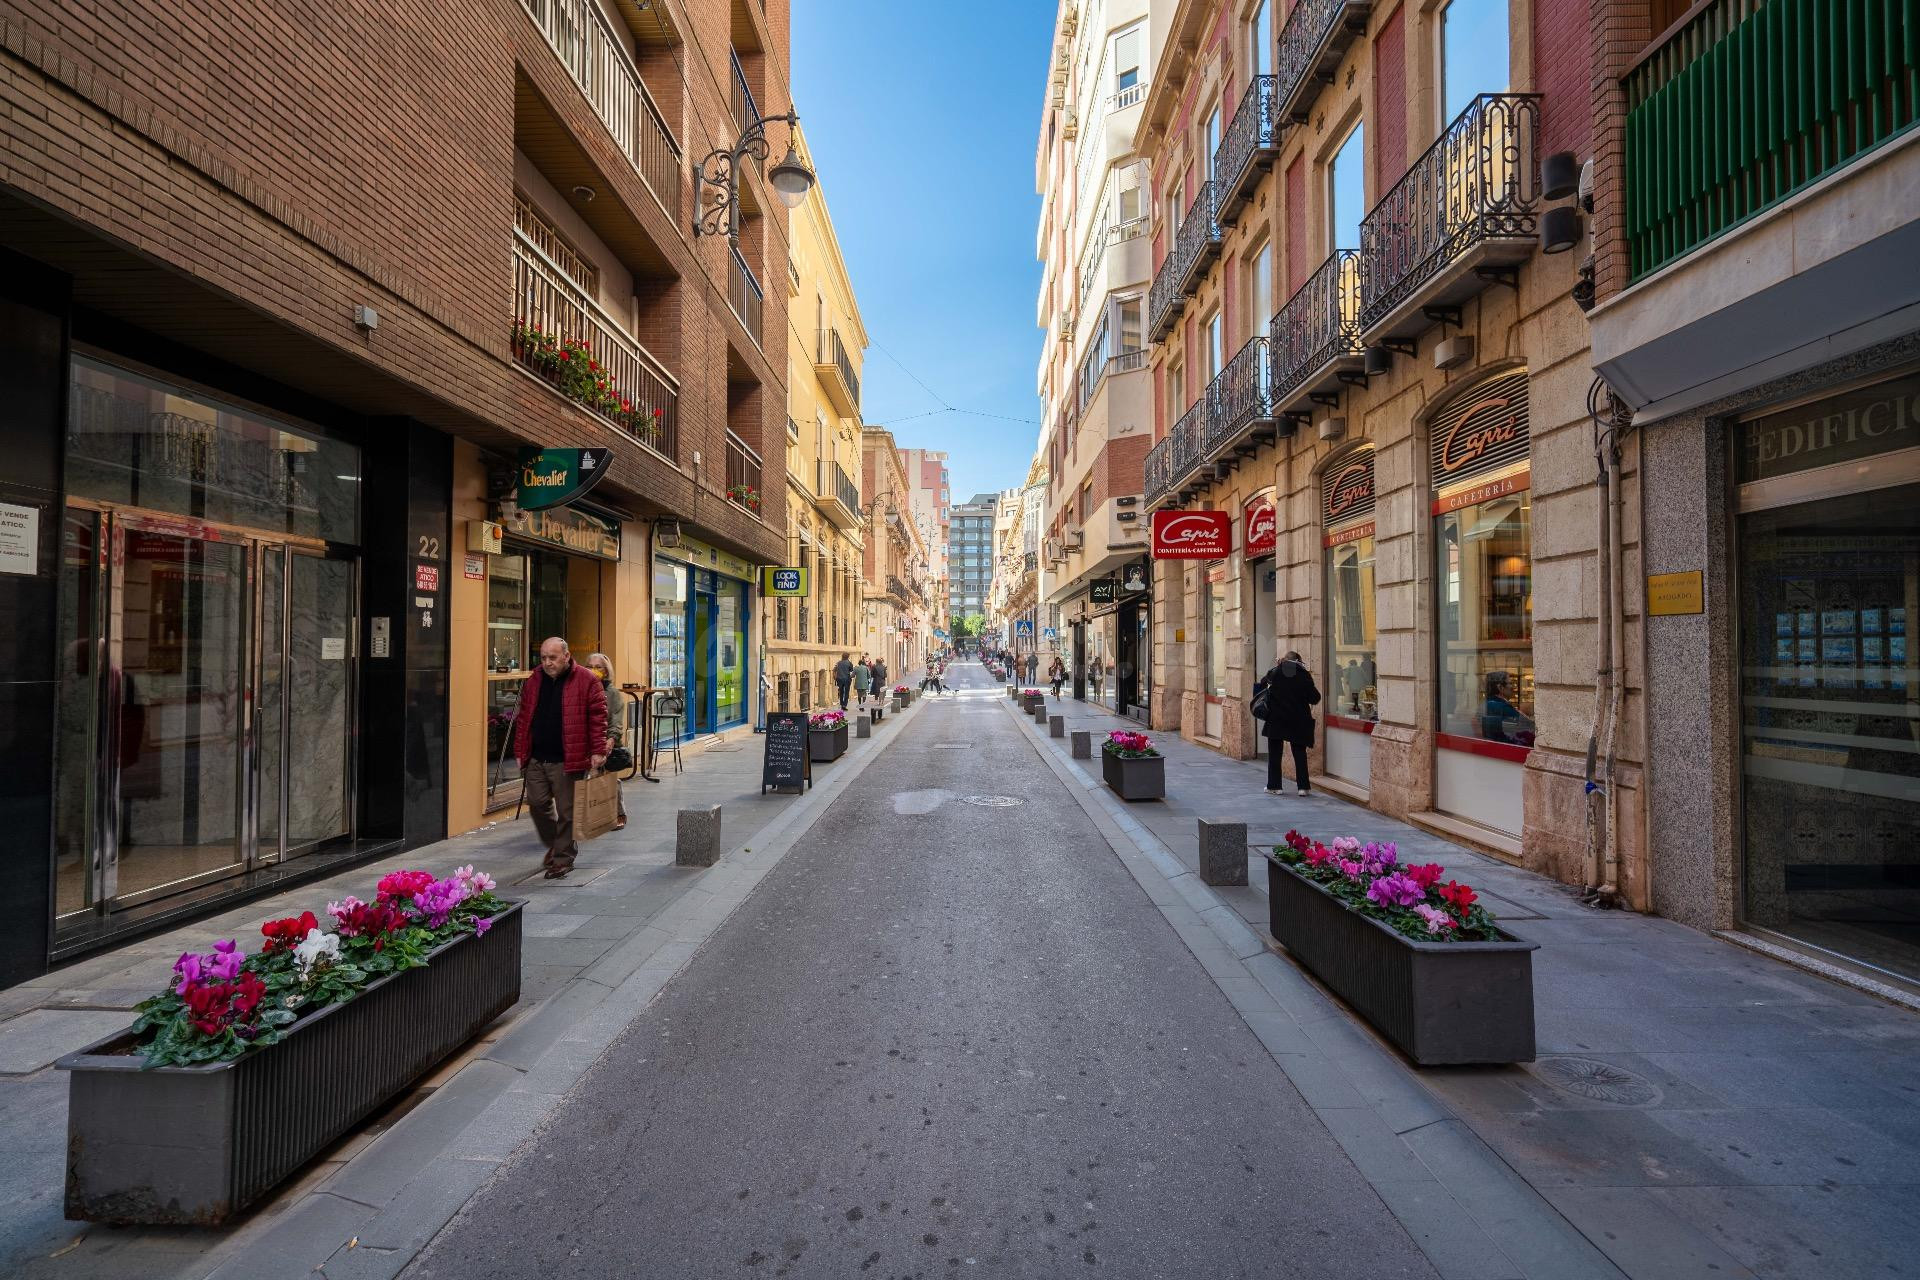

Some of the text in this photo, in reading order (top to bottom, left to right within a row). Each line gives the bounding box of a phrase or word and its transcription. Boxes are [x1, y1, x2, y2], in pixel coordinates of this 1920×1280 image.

[1443, 398, 1515, 471] Capri
[1759, 393, 1920, 462] EDIFICI
[523, 469, 567, 487] Chevalier
[1330, 464, 1371, 516] Capri
[1450, 480, 1513, 508] CAFETERÍA
[528, 510, 602, 552] Chevalier
[1160, 515, 1219, 544] Capri
[418, 535, 439, 559] 22
[776, 571, 798, 580] LOOK
[777, 581, 797, 589] FIND
